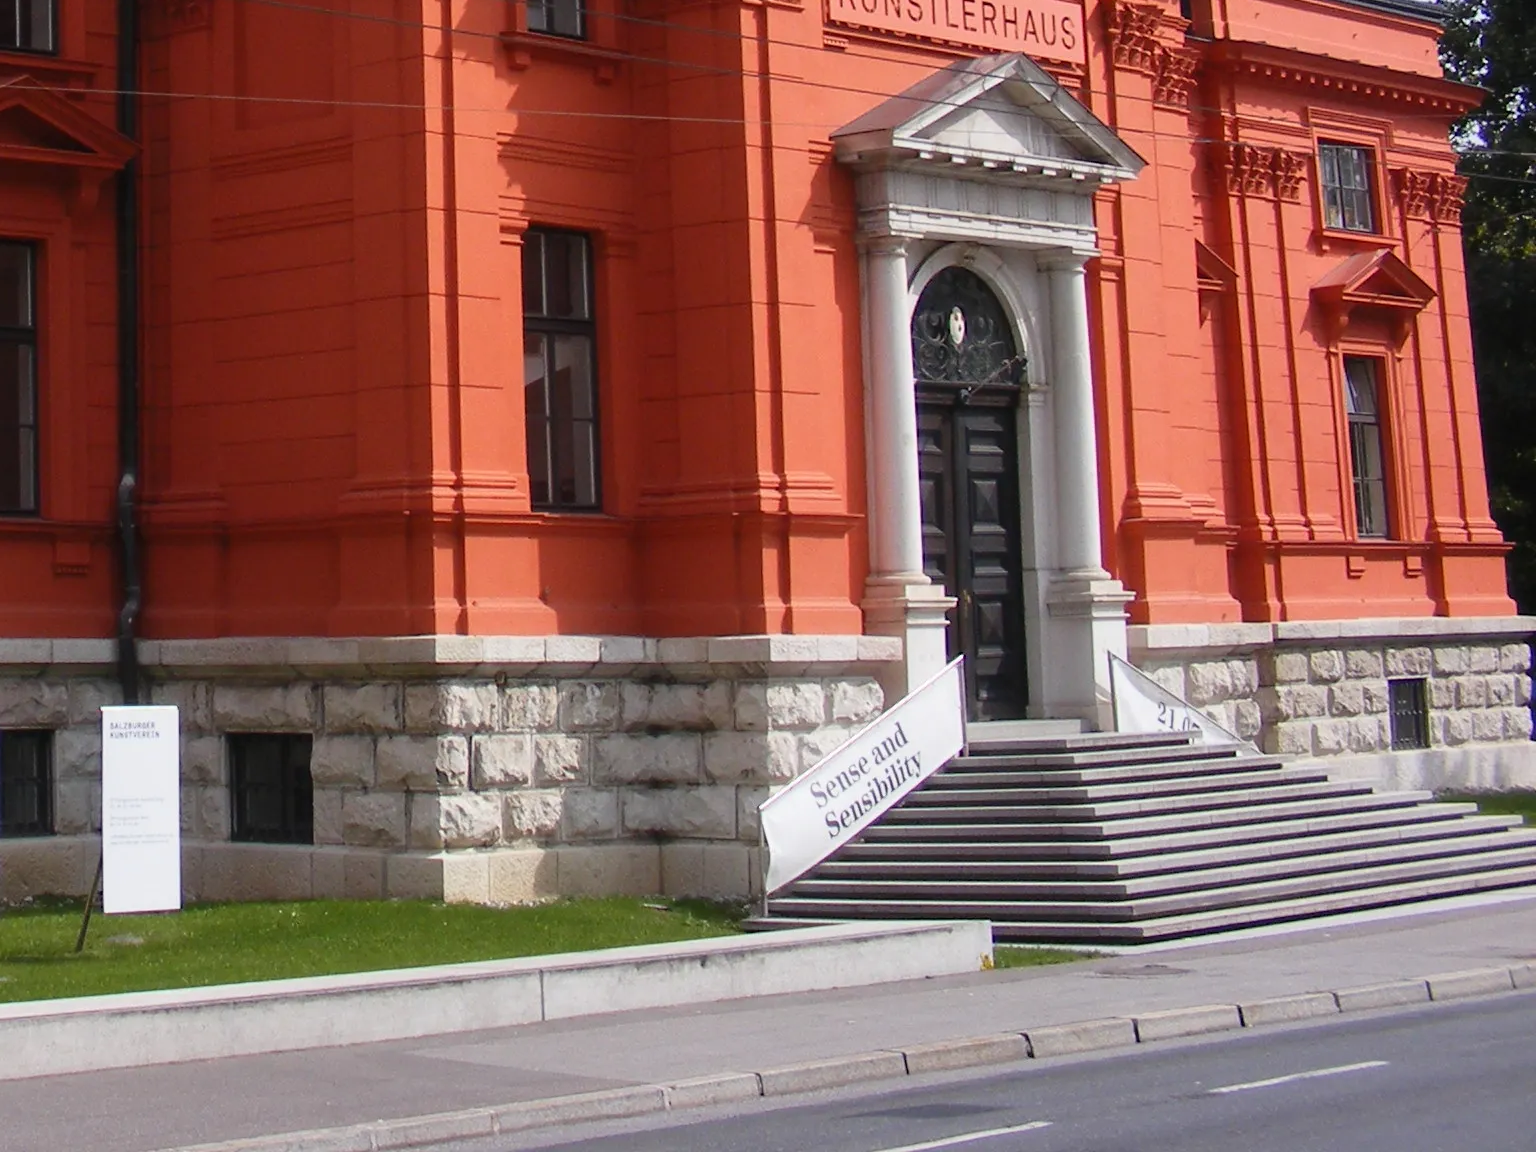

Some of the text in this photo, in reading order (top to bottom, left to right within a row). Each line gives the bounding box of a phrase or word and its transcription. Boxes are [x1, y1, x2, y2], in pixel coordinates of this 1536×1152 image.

[109, 721, 155, 730] SALZBURGER
[109, 730, 160, 739] KUNSTVEREIN
[810, 721, 909, 809] Sense and
[824, 750, 921, 839] Sensibility
